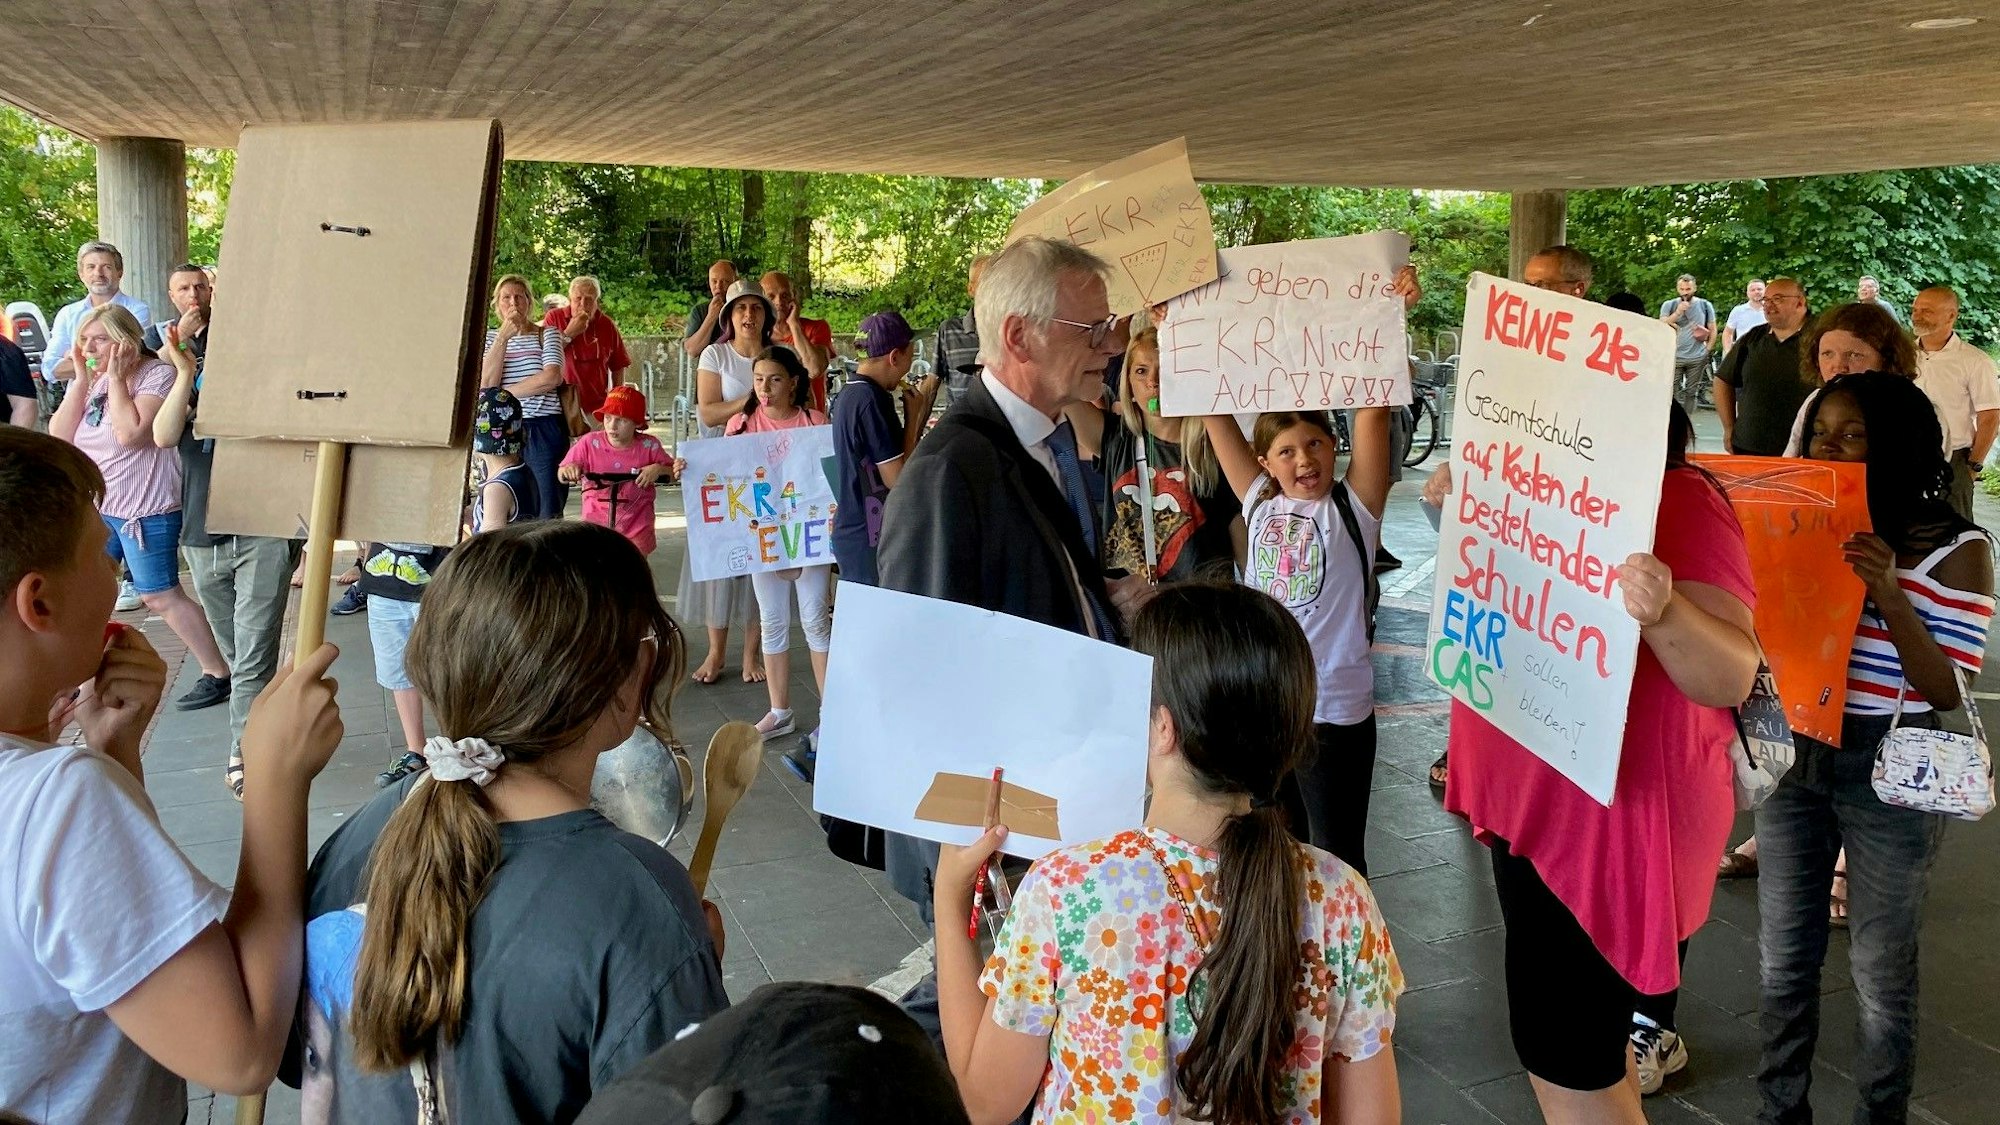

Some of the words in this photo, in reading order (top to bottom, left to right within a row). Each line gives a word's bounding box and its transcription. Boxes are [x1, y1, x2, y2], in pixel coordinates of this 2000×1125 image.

[1065, 196, 1155, 246] EKR
[1173, 194, 1201, 248] EKR
[1237, 262, 1329, 304] geben
[1348, 273, 1397, 299] die
[1170, 316, 1281, 374] EKR
[1303, 325, 1385, 367] Nicht
[1484, 284, 1573, 362] KEINE
[1585, 321, 1641, 382] 2te
[1464, 369, 1595, 461] Gesamtschule
[701, 482, 778, 523] EKR
[1462, 441, 1497, 481] auf
[1501, 441, 1565, 509] Kosten
[1570, 476, 1620, 528] der
[1443, 588, 1506, 669] EKR
[1454, 536, 1611, 679] Schulen
[1433, 638, 1494, 711] CAS
